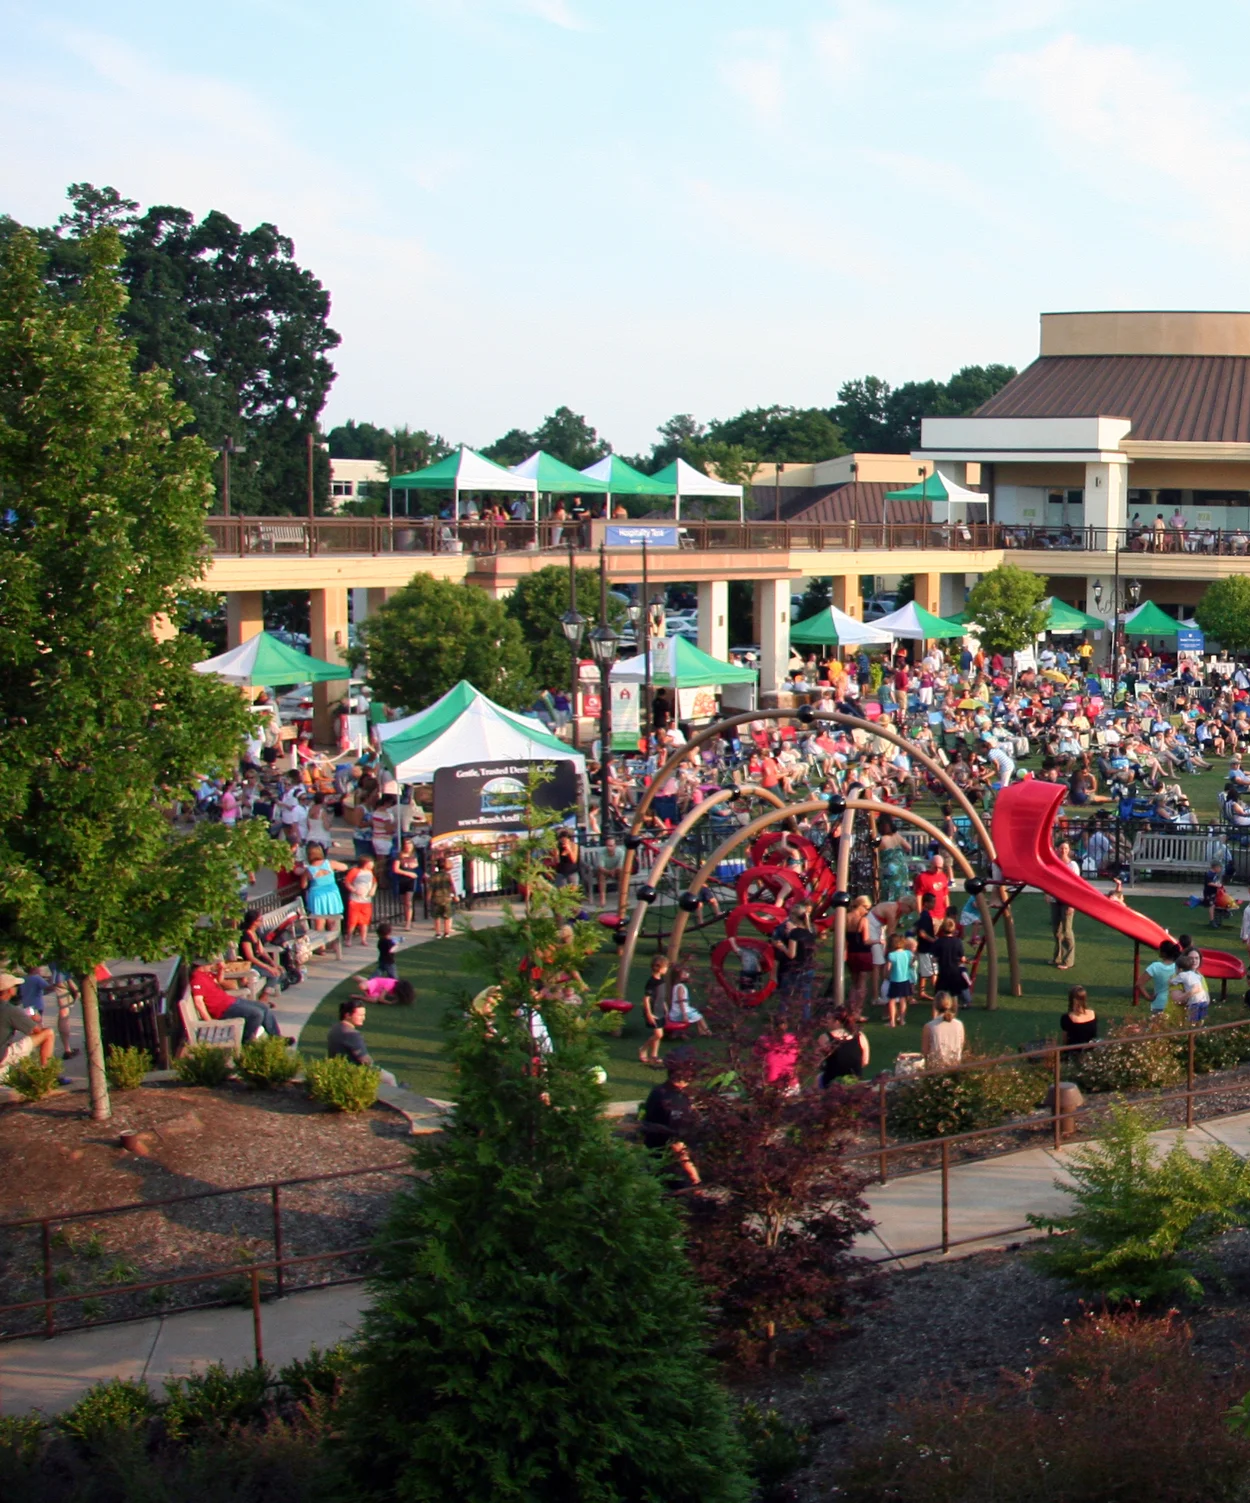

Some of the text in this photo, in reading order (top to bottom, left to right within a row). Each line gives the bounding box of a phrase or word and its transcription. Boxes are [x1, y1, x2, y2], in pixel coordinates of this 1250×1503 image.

[619, 528, 650, 538] Hospitality
[456, 769, 480, 778] Gentle,
[480, 766, 509, 776] Trusted
[509, 765, 532, 774] Dent
